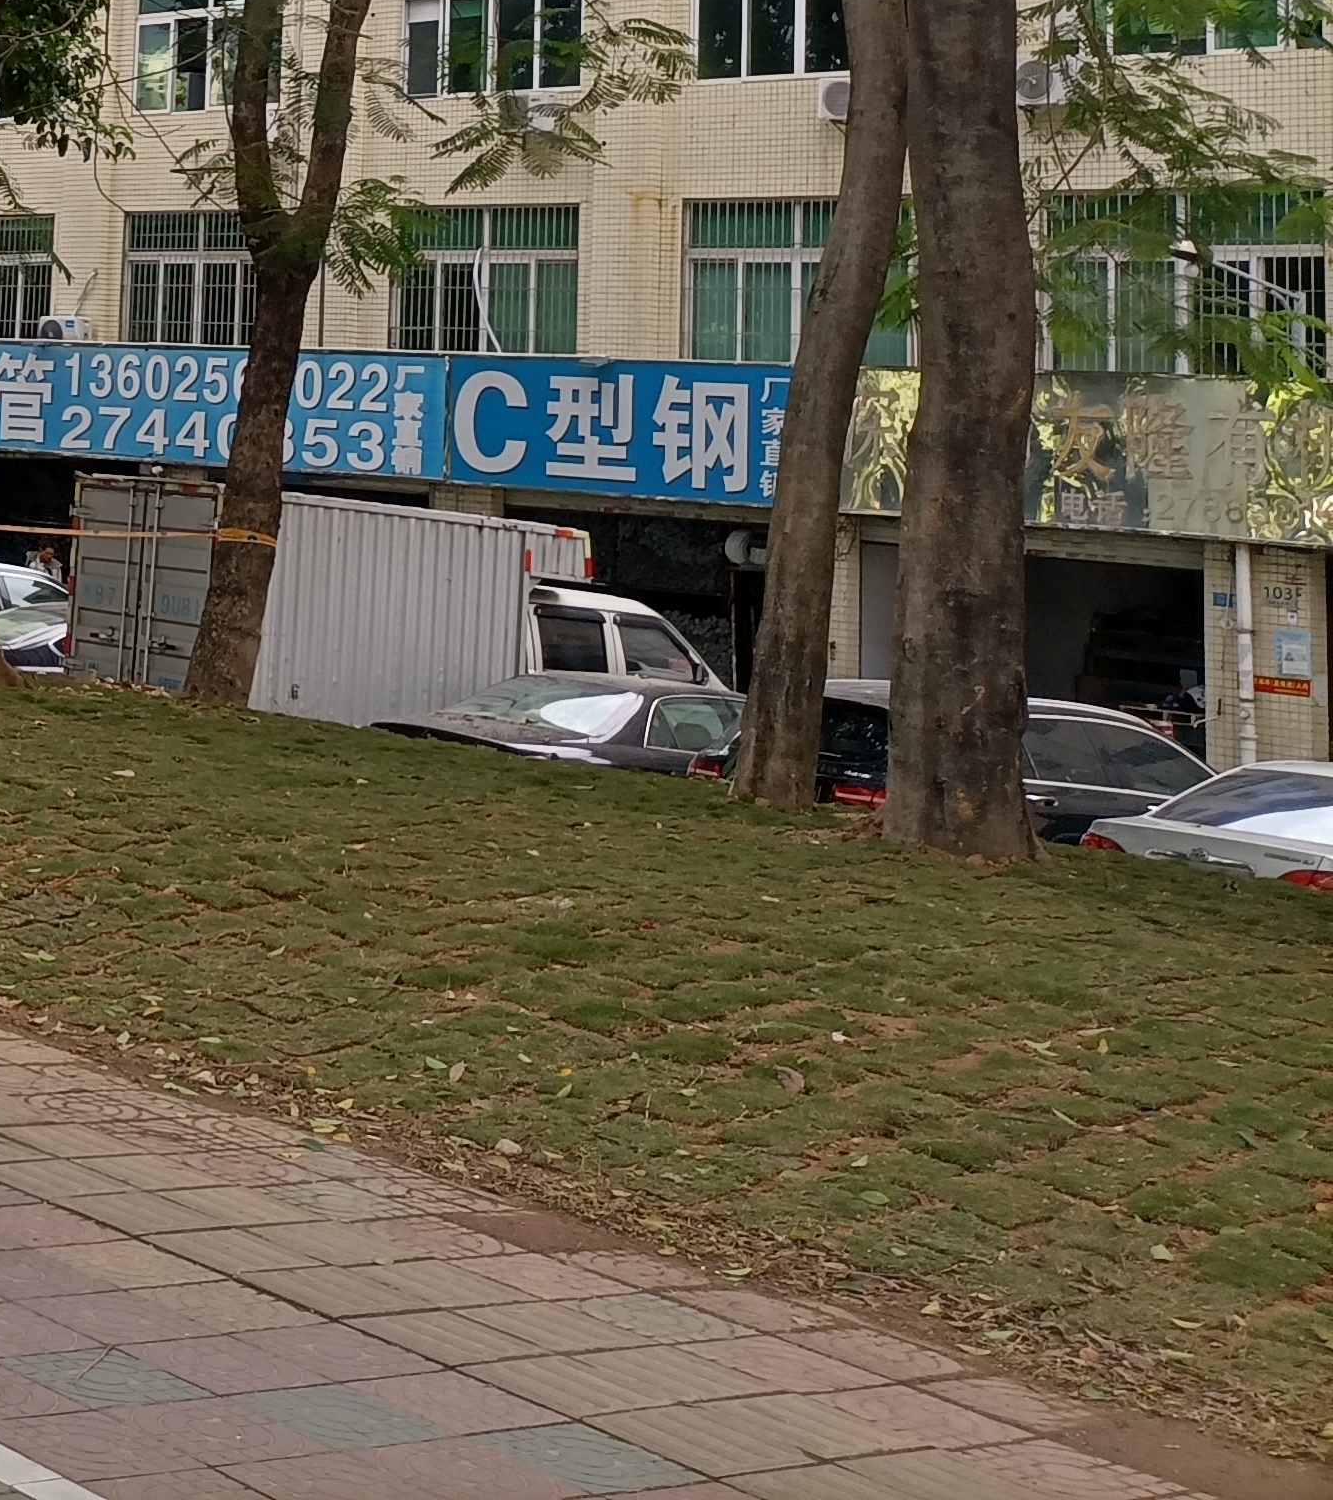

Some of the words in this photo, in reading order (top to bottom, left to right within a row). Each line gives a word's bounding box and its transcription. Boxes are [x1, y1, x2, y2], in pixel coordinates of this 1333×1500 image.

[391, 365, 425, 476] 厂家直销
[452, 367, 752, 494] C型钢
